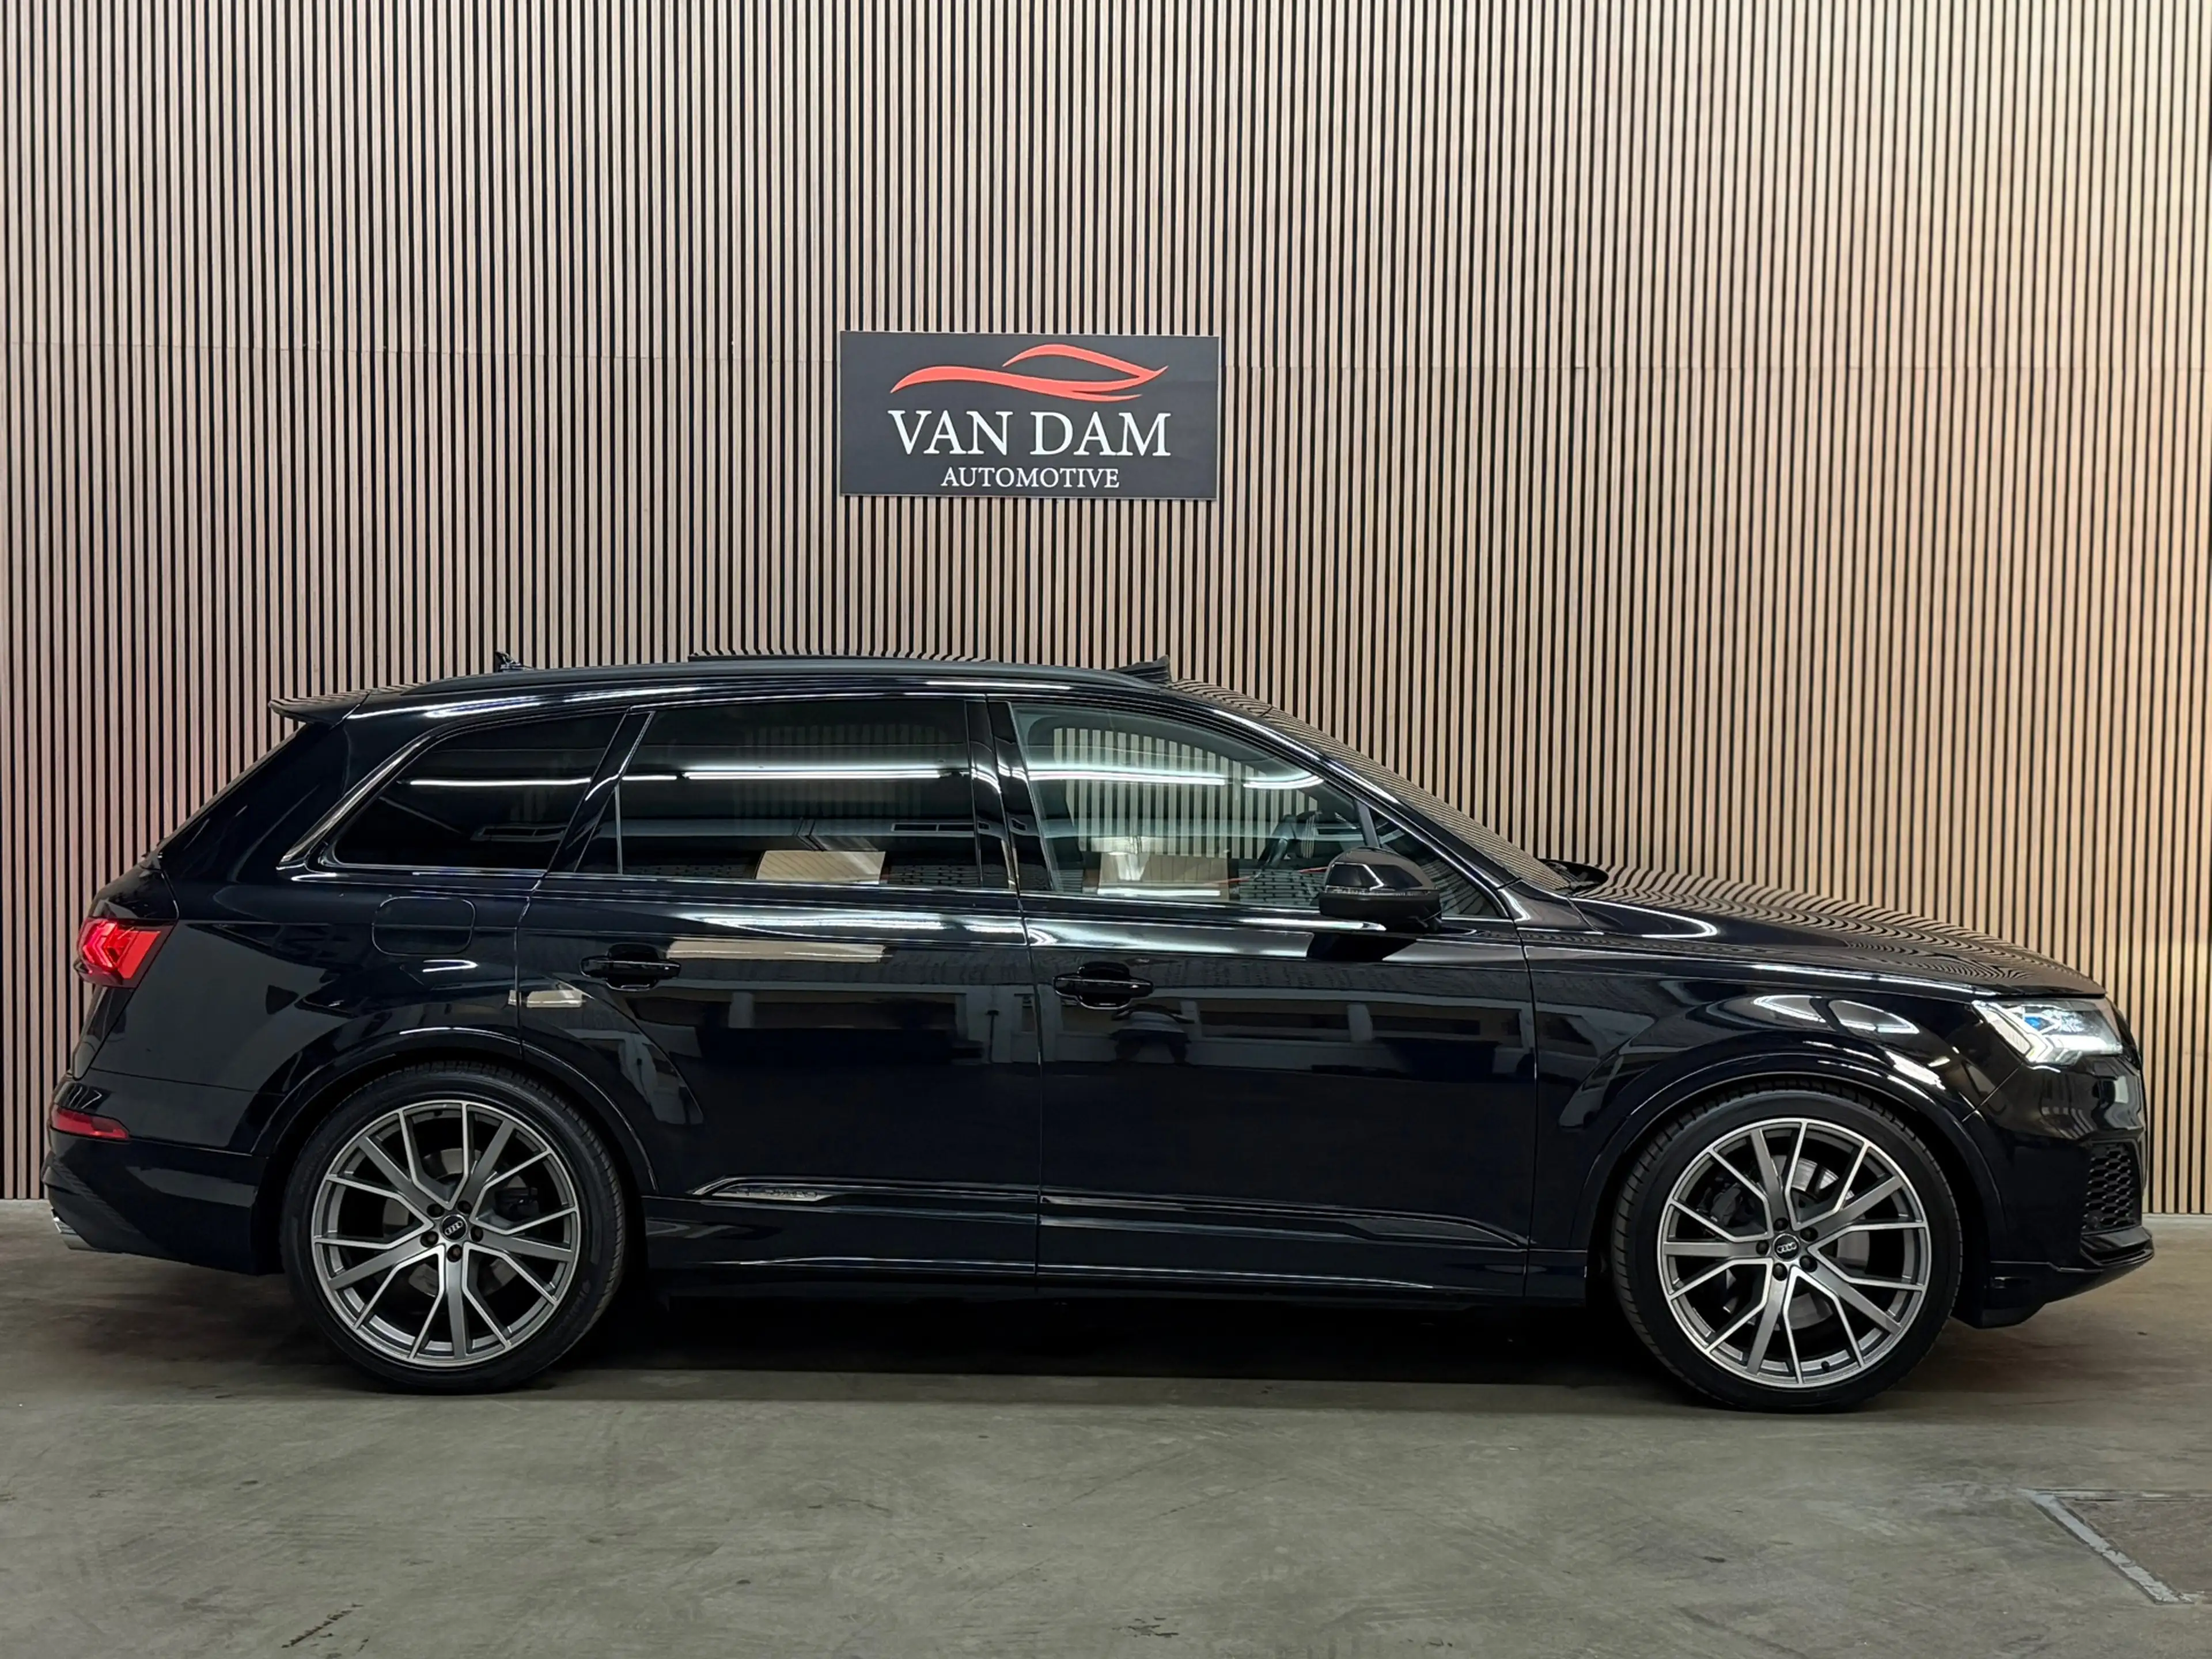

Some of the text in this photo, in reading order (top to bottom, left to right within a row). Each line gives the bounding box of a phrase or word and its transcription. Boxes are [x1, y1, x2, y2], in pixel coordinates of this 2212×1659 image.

[887, 410, 1172, 457] VAN DAM
[940, 467, 1120, 488] AUTOMOTIVE
